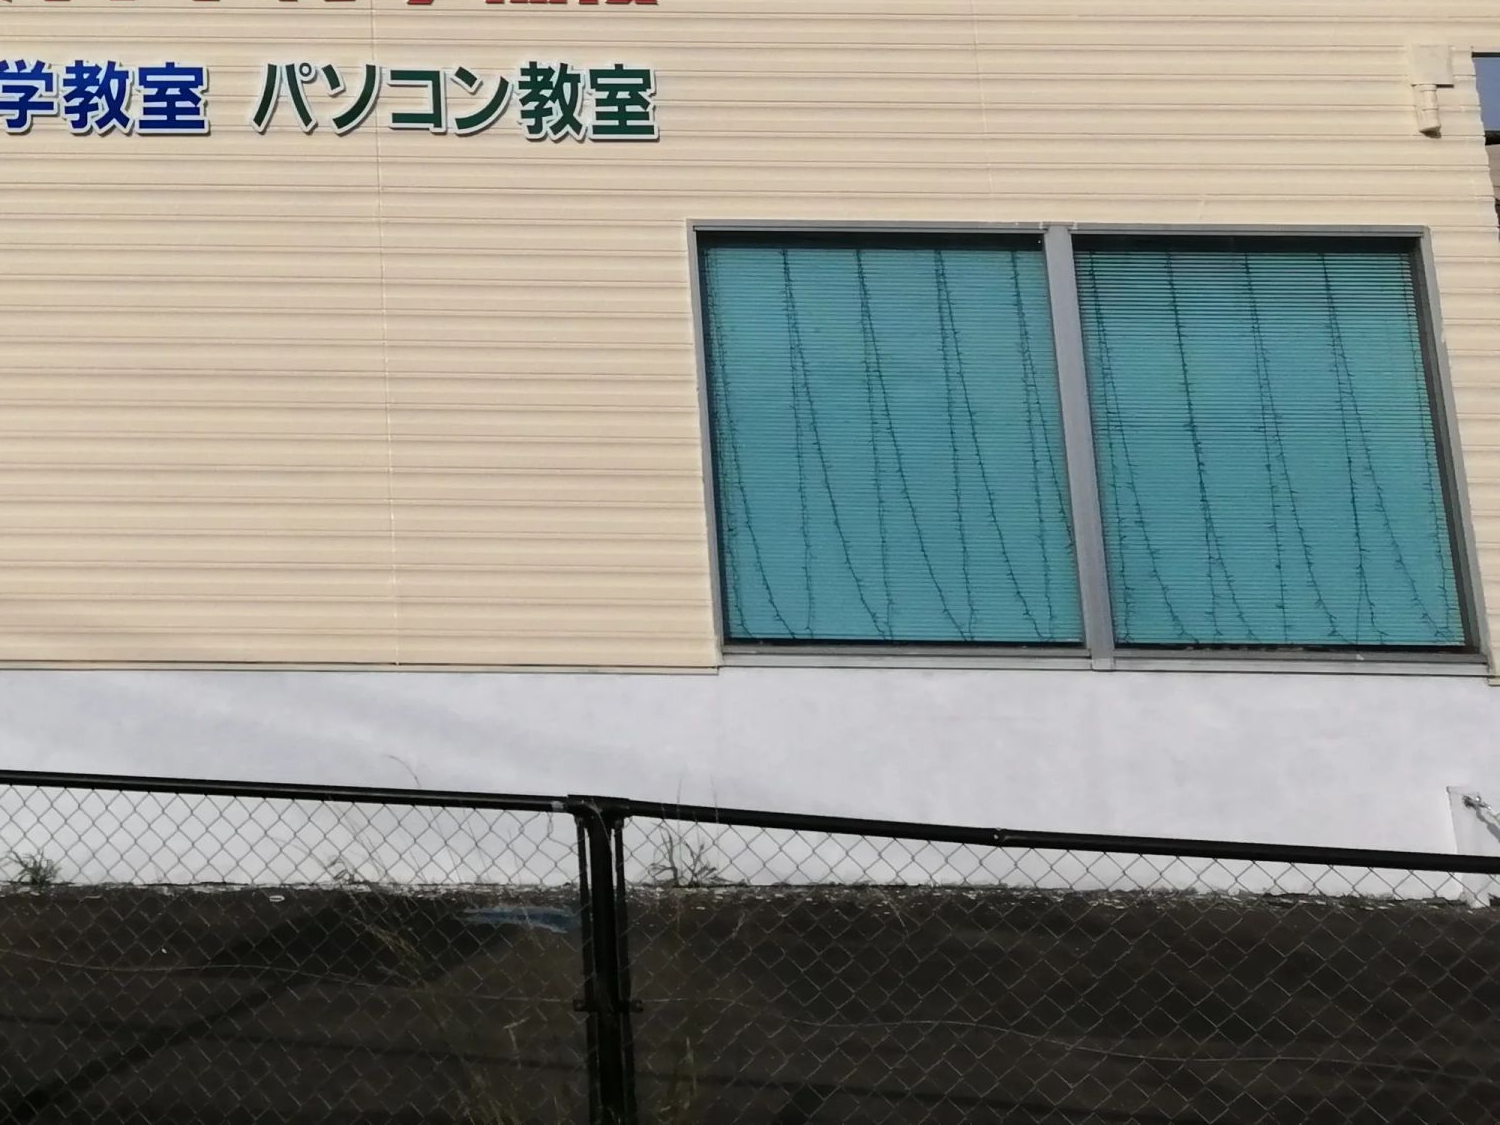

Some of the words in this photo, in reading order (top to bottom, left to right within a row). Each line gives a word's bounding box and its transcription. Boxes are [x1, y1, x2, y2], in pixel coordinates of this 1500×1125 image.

[254, 60, 658, 141] パソコン教室
